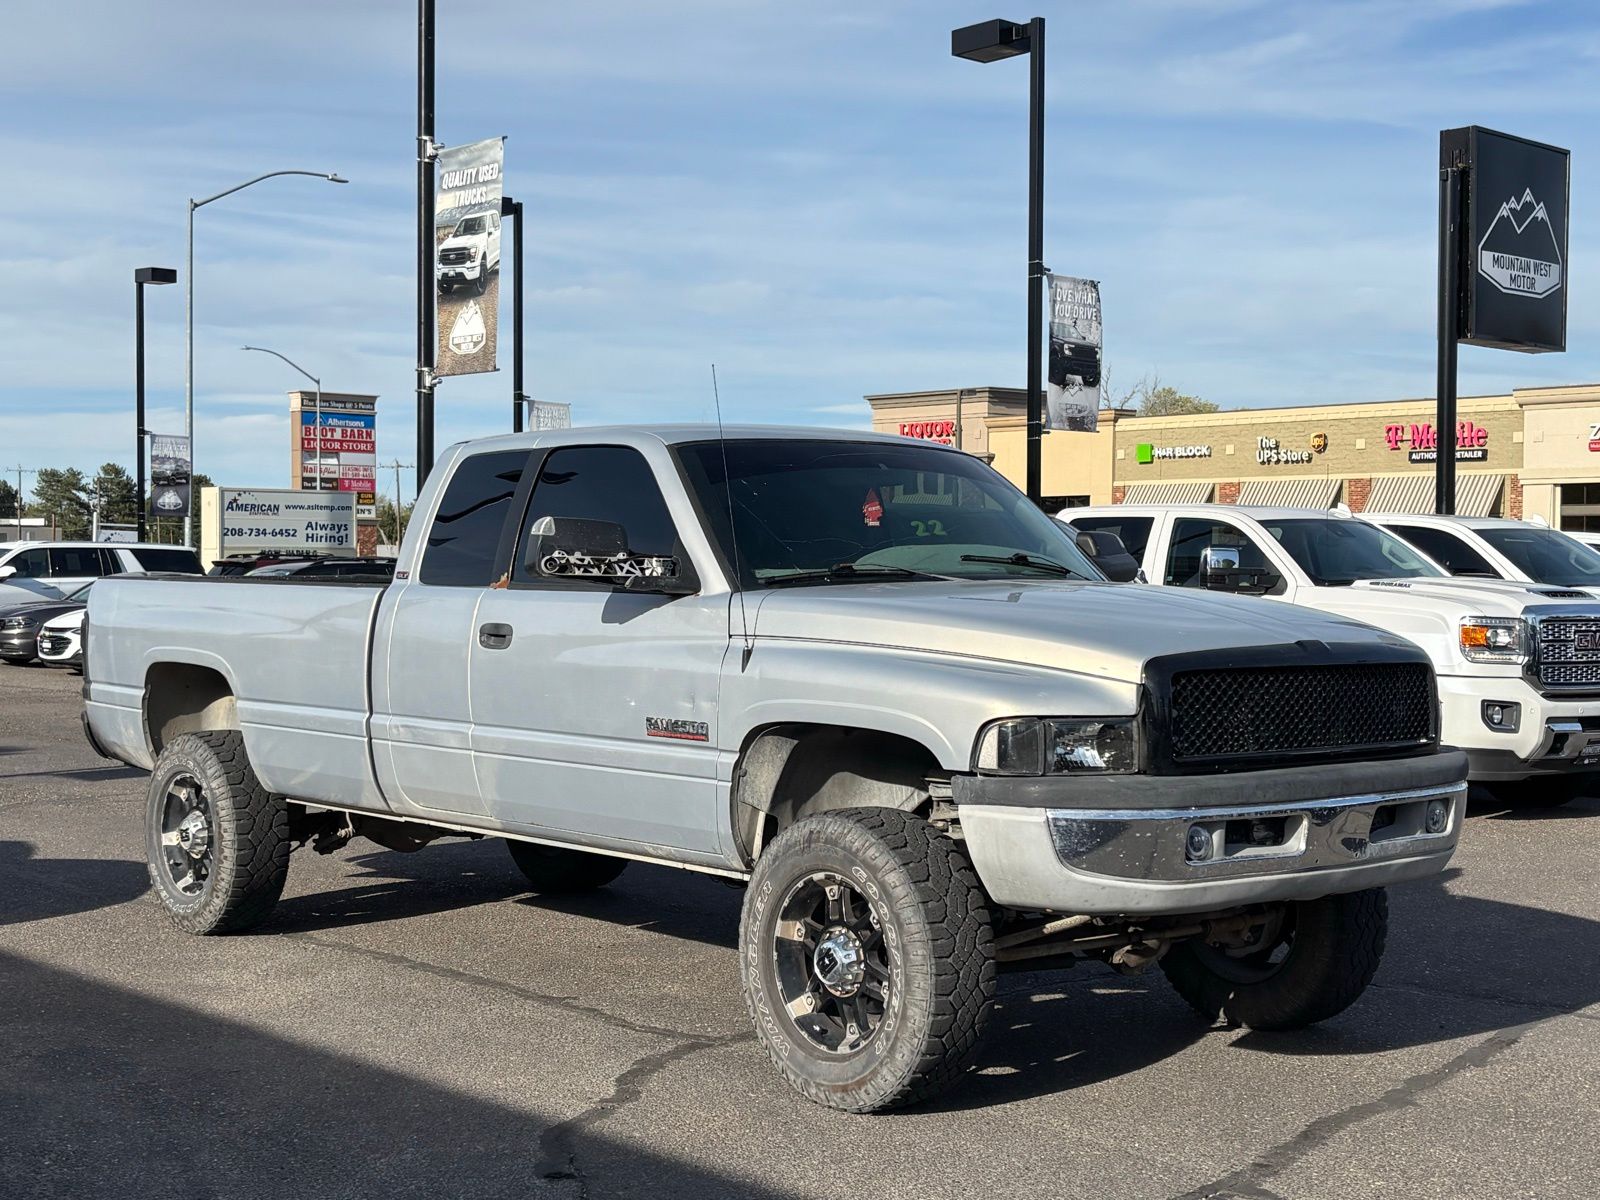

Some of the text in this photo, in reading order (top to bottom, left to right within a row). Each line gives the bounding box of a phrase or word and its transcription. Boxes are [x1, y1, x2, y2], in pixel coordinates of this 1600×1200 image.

[442, 163, 499, 190] QUALITY USED
[455, 187, 487, 207] TRUCKS
[1492, 254, 1552, 278] MOUNTAIN WEST
[1509, 273, 1536, 290] MOTOR
[1074, 290, 1096, 305] WHAT
[1055, 303, 1097, 320] YOU DRIVE
[327, 417, 364, 427] Albertsons
[899, 421, 954, 439] LIQUOR
[304, 426, 373, 440] BOOT BARN
[1385, 421, 1488, 449] T-Moile
[304, 440, 373, 451] LIQUOR STORE
[1256, 436, 1276, 449] The
[1174, 445, 1209, 457] BLOCK
[1256, 449, 1310, 462] UPS Store
[226, 501, 280, 513] AMERICAN
[305, 521, 349, 533] Always
[911, 520, 947, 536] 22
[305, 533, 349, 546] Hiring!
[1575, 632, 1600, 649] GM
[749, 880, 791, 1056] WRANGLER
[851, 866, 901, 1055] GOODYEAR
